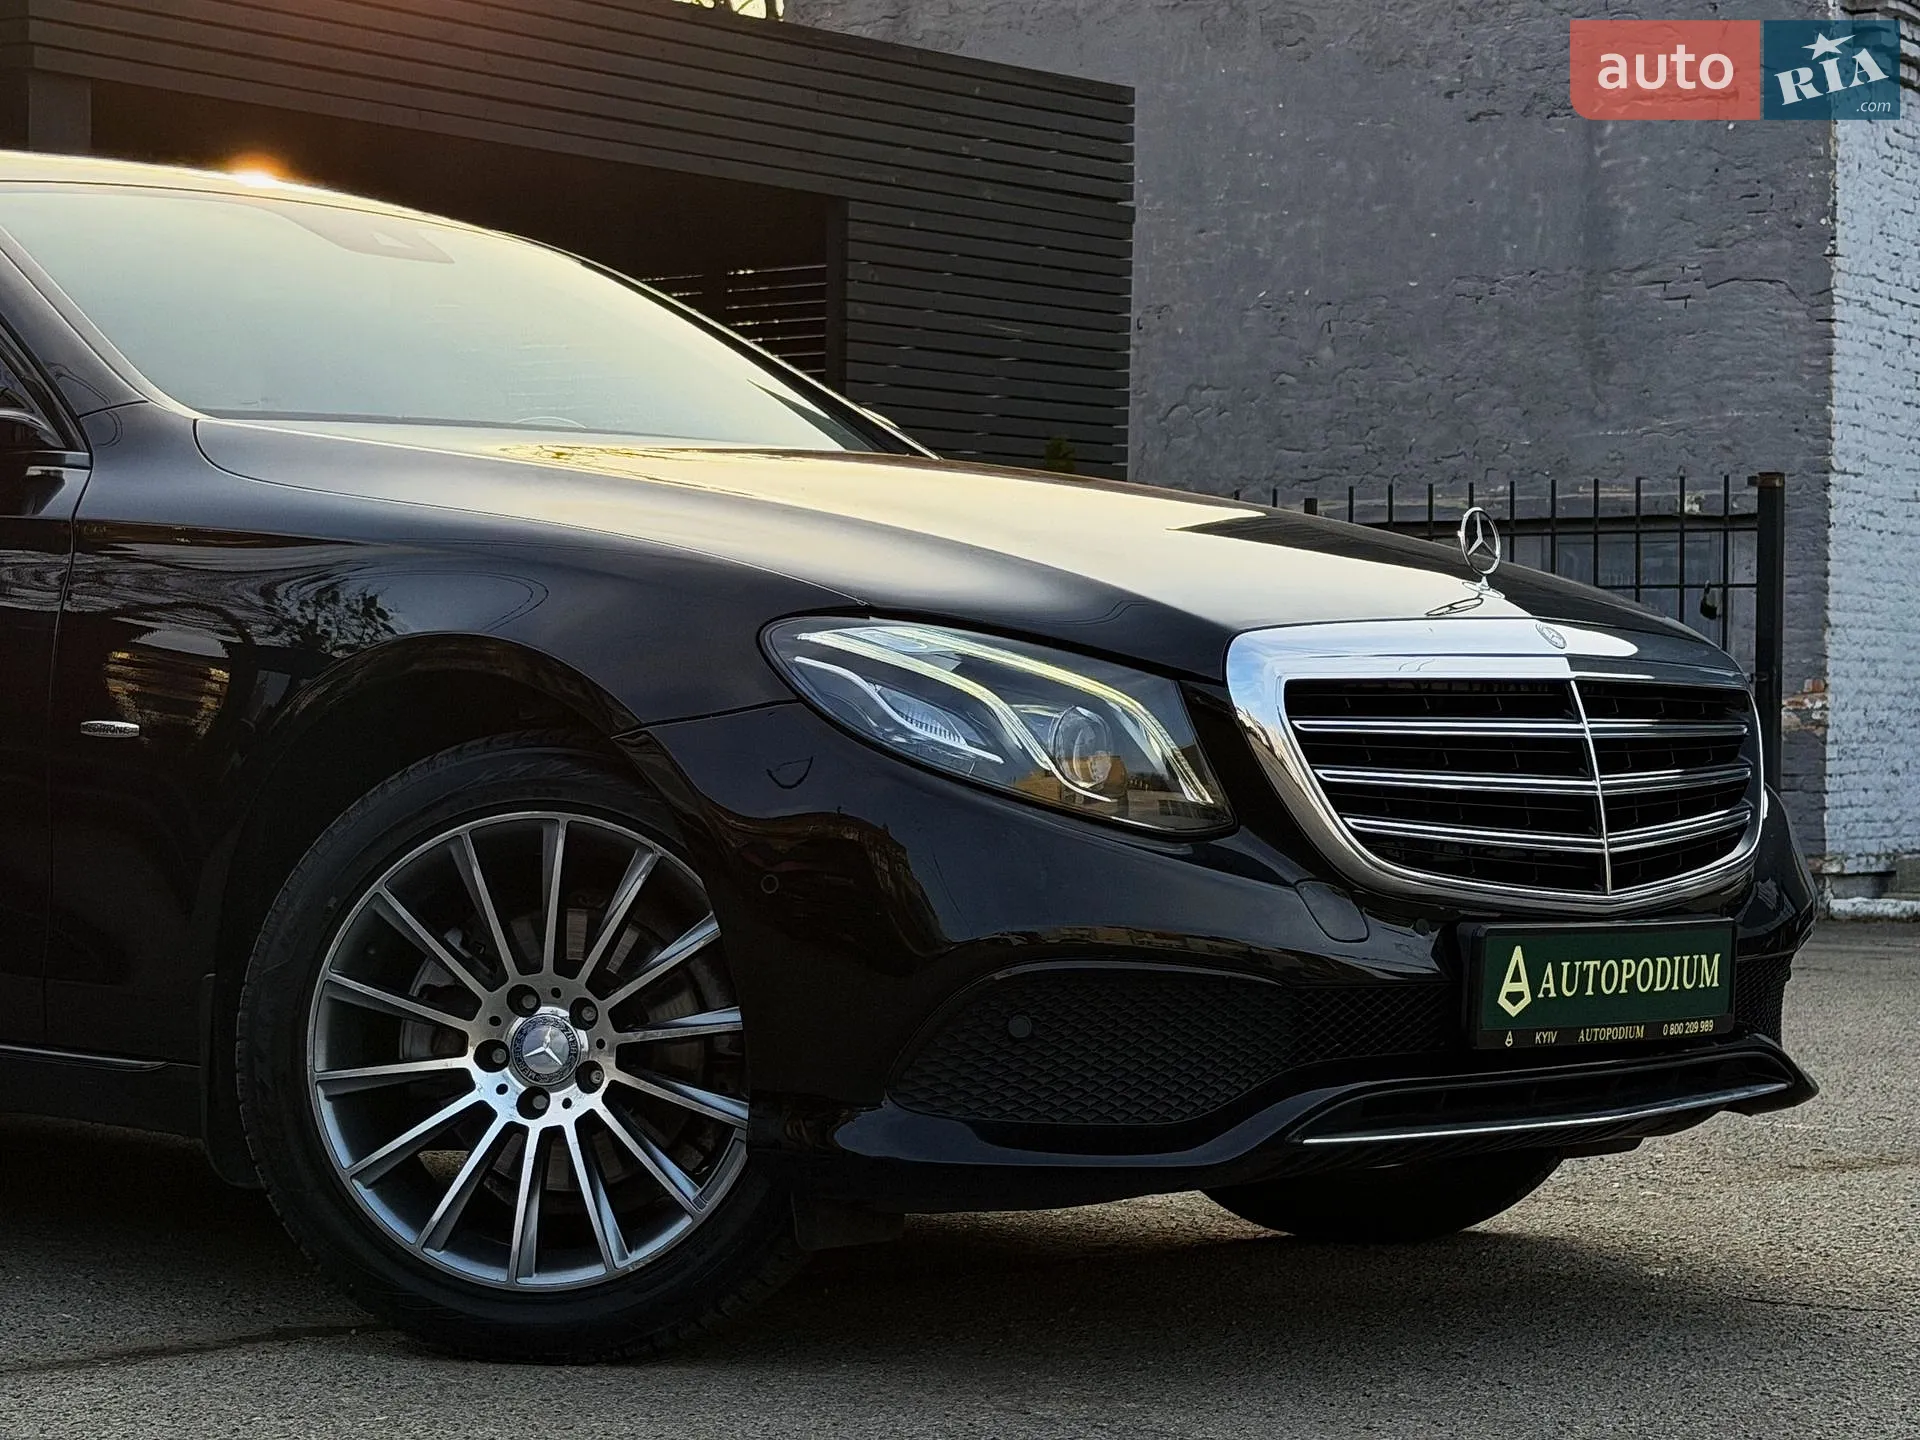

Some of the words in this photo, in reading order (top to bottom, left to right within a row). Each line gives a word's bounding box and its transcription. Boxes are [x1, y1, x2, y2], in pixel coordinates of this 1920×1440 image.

[1537, 953, 1721, 998] AUTOPODIUM
[1535, 1031, 1557, 1044] KYIV
[1578, 1025, 1645, 1042] AUTOPODIUM
